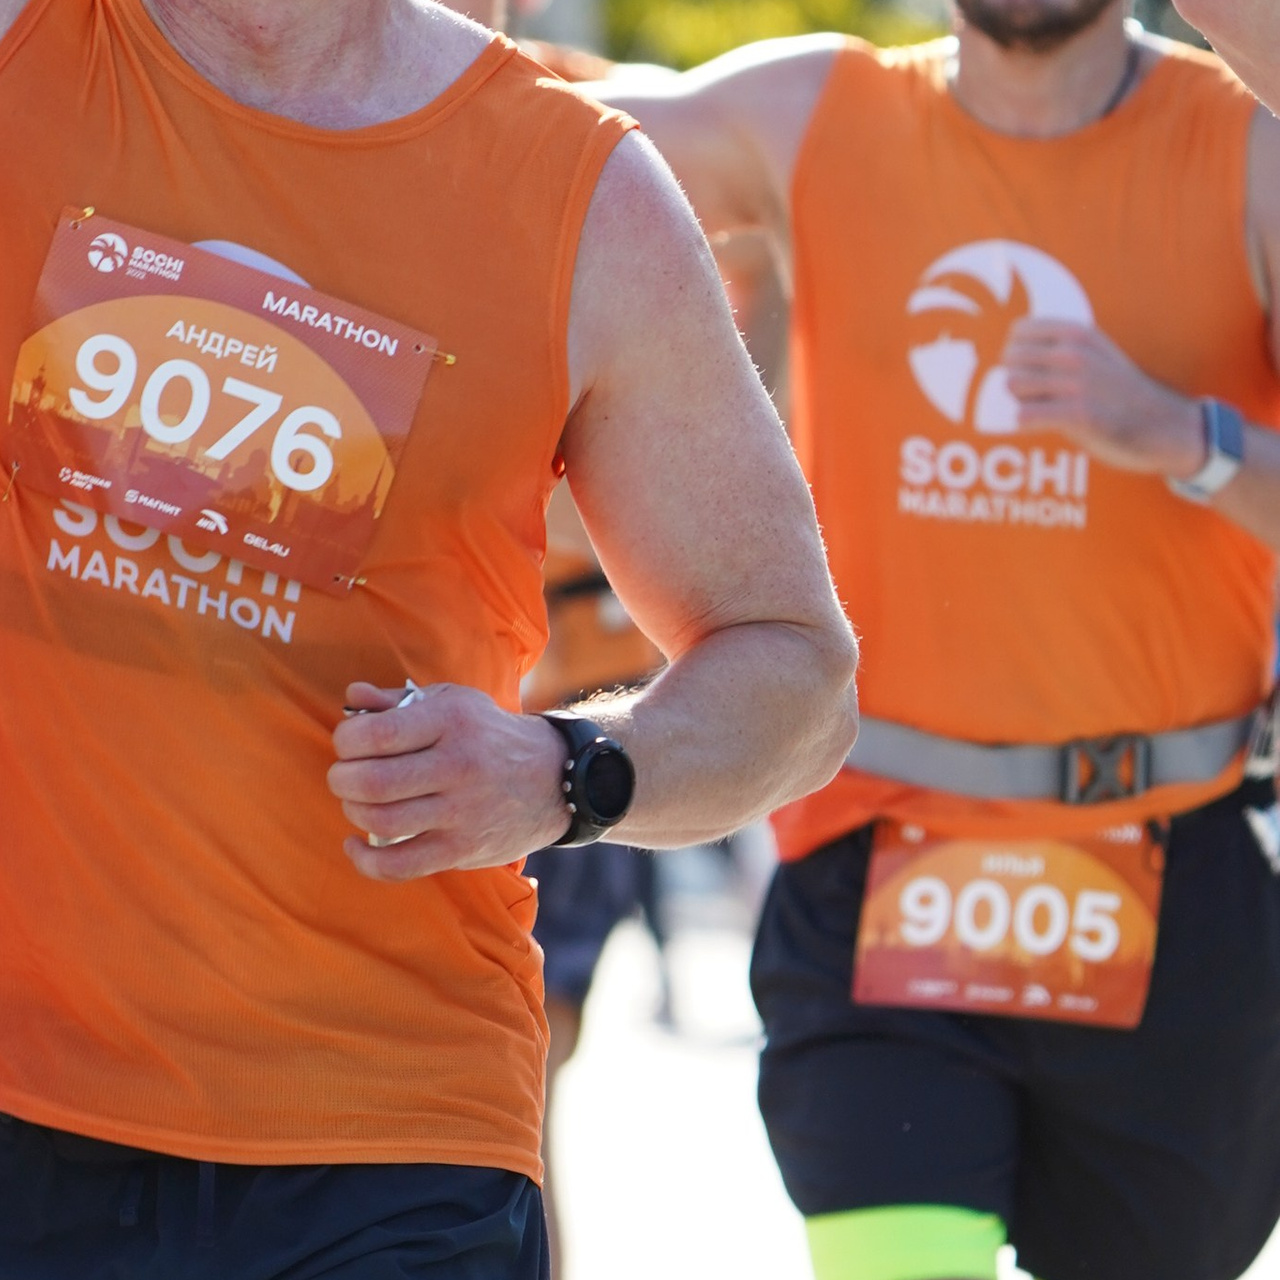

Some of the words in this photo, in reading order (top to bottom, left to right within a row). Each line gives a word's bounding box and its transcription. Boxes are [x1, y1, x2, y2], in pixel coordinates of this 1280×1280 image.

[131, 246, 184, 272] SOCHI
[166, 320, 279, 374] АНДРЕЙ
[262, 291, 399, 356] MARATHON
[69, 333, 342, 492] 9076
[900, 435, 1088, 497] SOCHI
[898, 487, 1087, 529] MARATHON
[46, 538, 296, 643] MARATHON
[899, 875, 1121, 962] 9005
